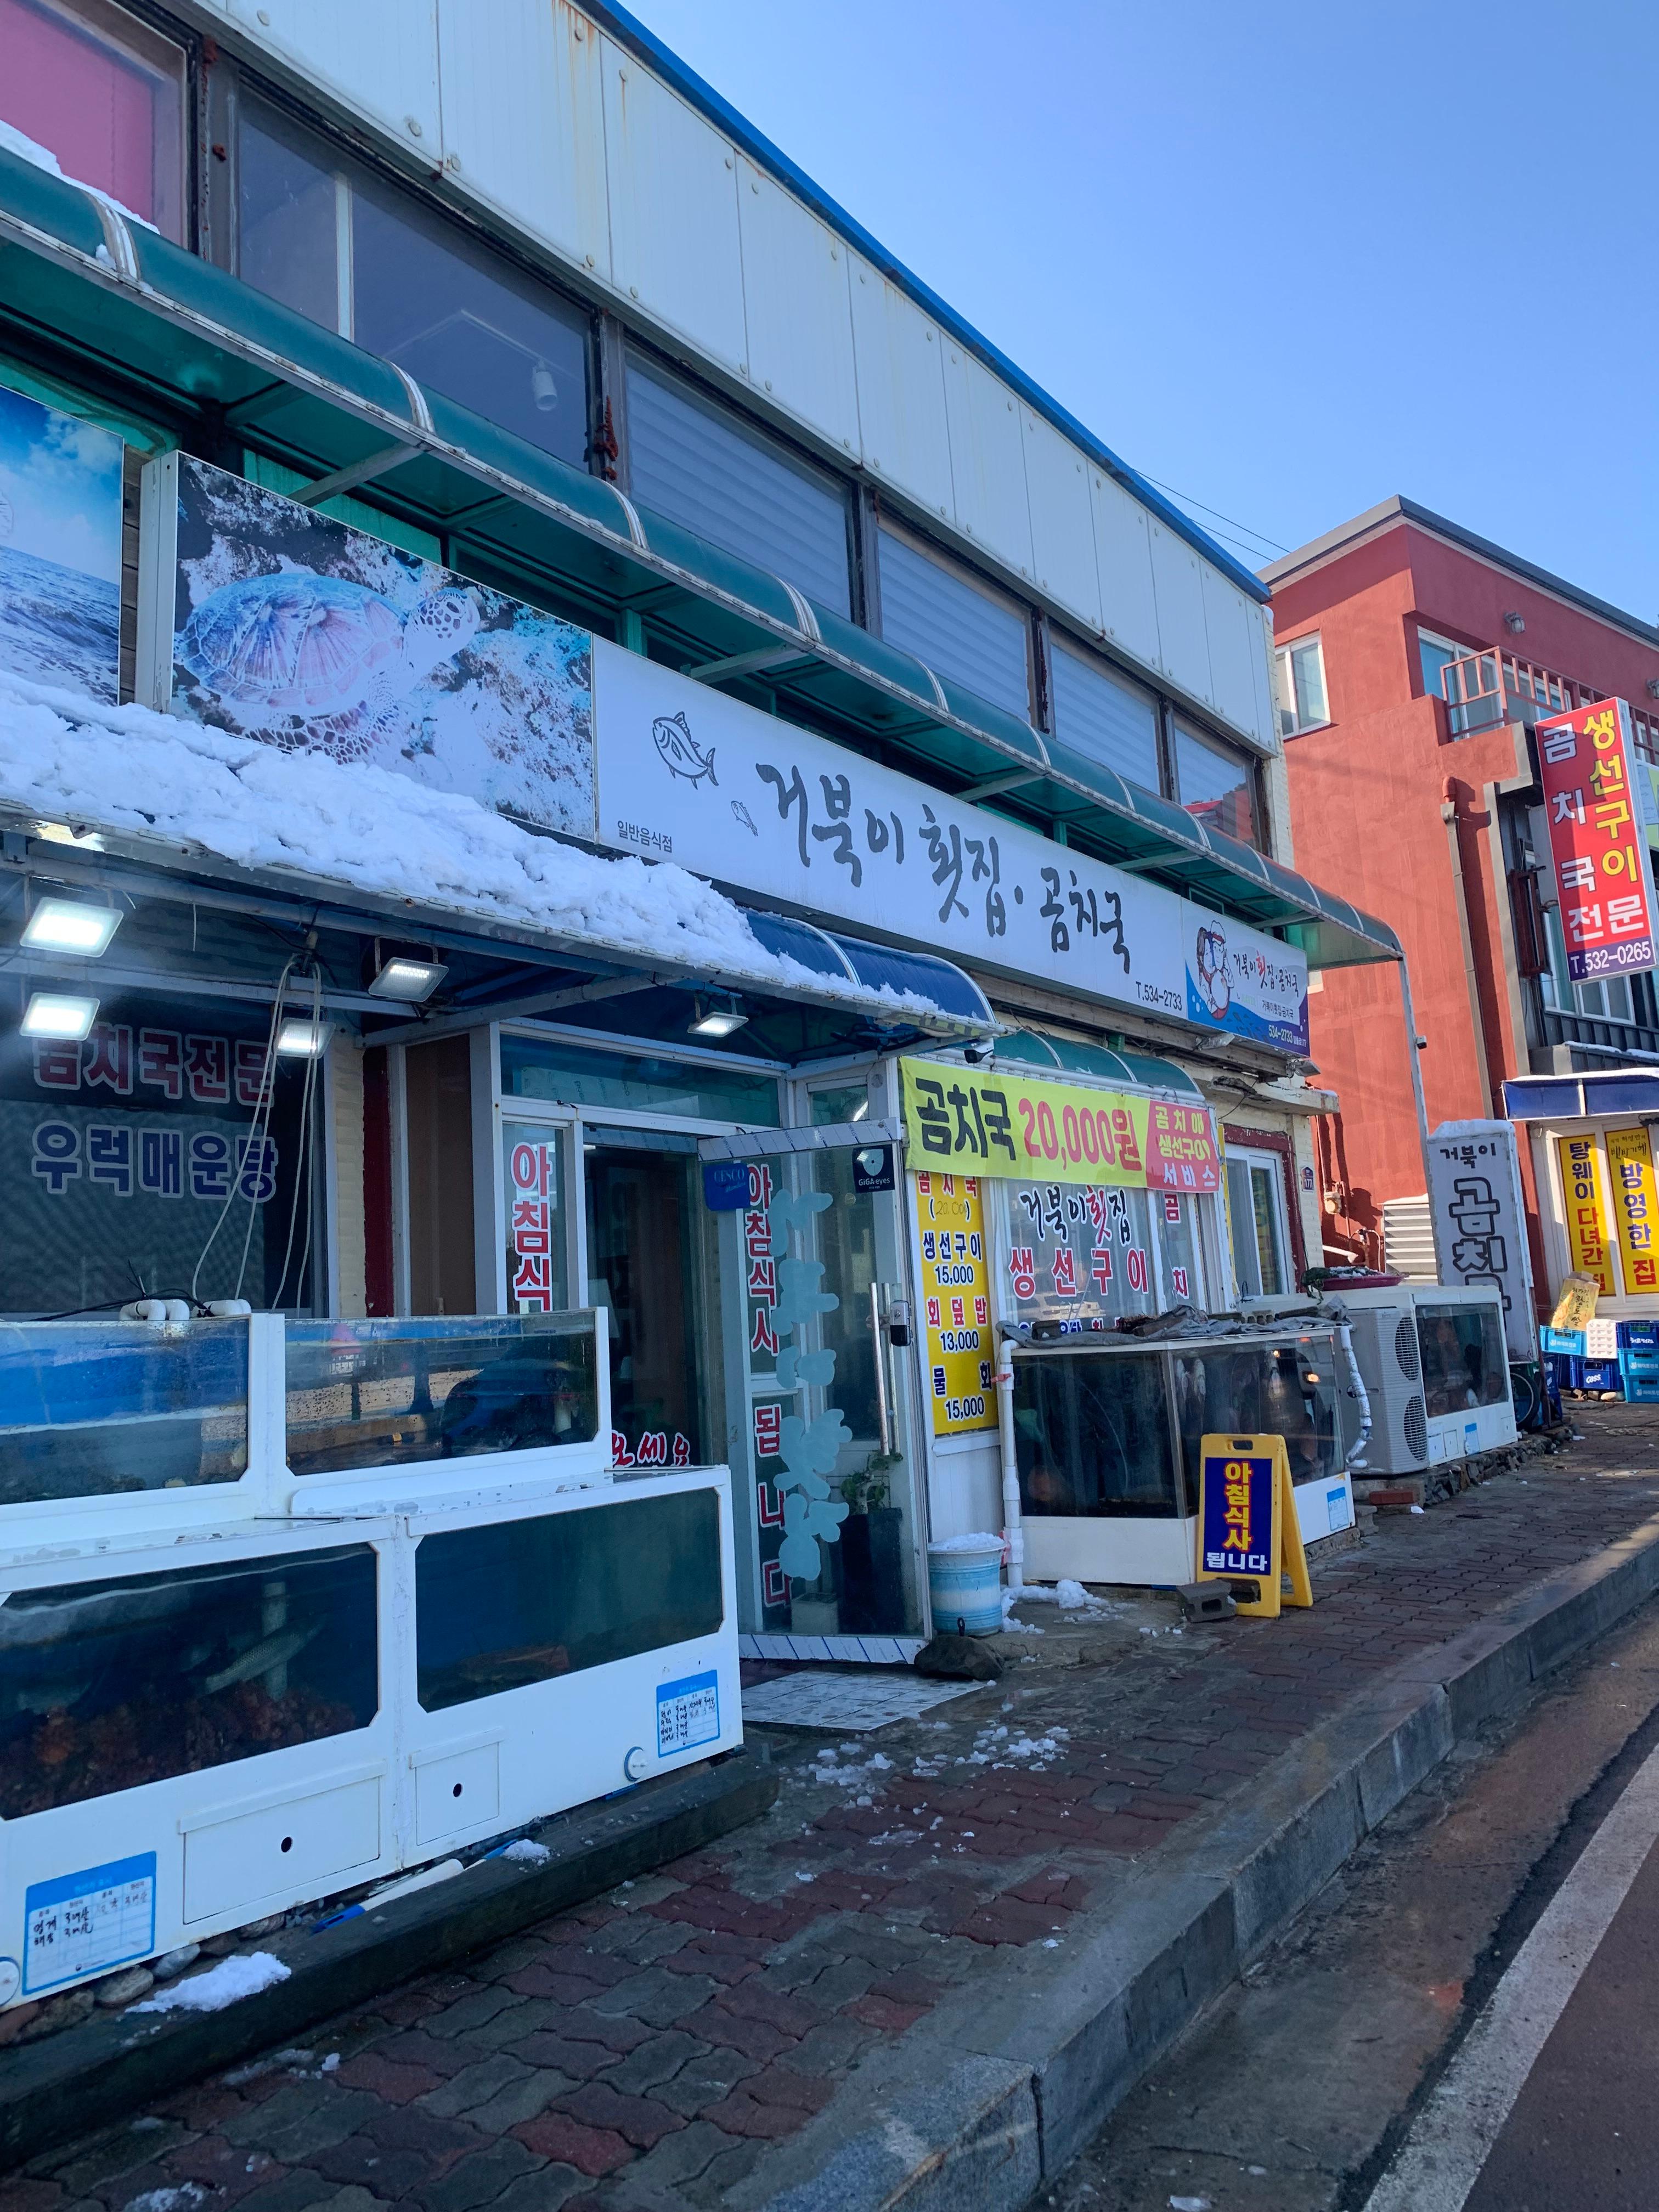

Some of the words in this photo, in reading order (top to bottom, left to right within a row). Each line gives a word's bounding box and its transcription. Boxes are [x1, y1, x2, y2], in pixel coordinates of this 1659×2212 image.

[1542, 723, 1596, 893] 곰치국
[1583, 709, 1639, 883] 생선구이
[617, 820, 673, 853] 일반음식점
[1567, 894, 1644, 943] 전문
[1570, 940, 1652, 975] T.532-0265
[1136, 980, 1182, 1012] T.534-2733
[1268, 1024, 1293, 1043] 534-2733
[916, 1077, 1017, 1161] 곰치국
[1019, 1097, 1143, 1172] 20,000원
[31, 1119, 278, 1203] 우럭매운탕
[1159, 1135, 1211, 1161] 생선구이
[1440, 1143, 1496, 1169] 거북이
[1164, 1163, 1216, 1187] 서비스
[1304, 1178, 1312, 1188] 177
[1569, 1142, 1595, 1199] 탕웨이
[1019, 1184, 1131, 1247] 거북이횟집
[1620, 1163, 1652, 1249] 방영한
[511, 1142, 553, 1312] 아침식
[1577, 1207, 1604, 1266] 다녀간
[744, 1164, 780, 1356] 아침식사
[923, 1231, 983, 1262] 생선구이
[935, 1265, 974, 1285] 15,000
[1009, 1247, 1148, 1300] 생선구이
[1633, 1259, 1656, 1285] 집
[940, 1330, 979, 1353] 13,000
[945, 1397, 985, 1421] 15,000
[1222, 1462, 1253, 1553] 아침식사
[1206, 1551, 1267, 1571] 됩니다
